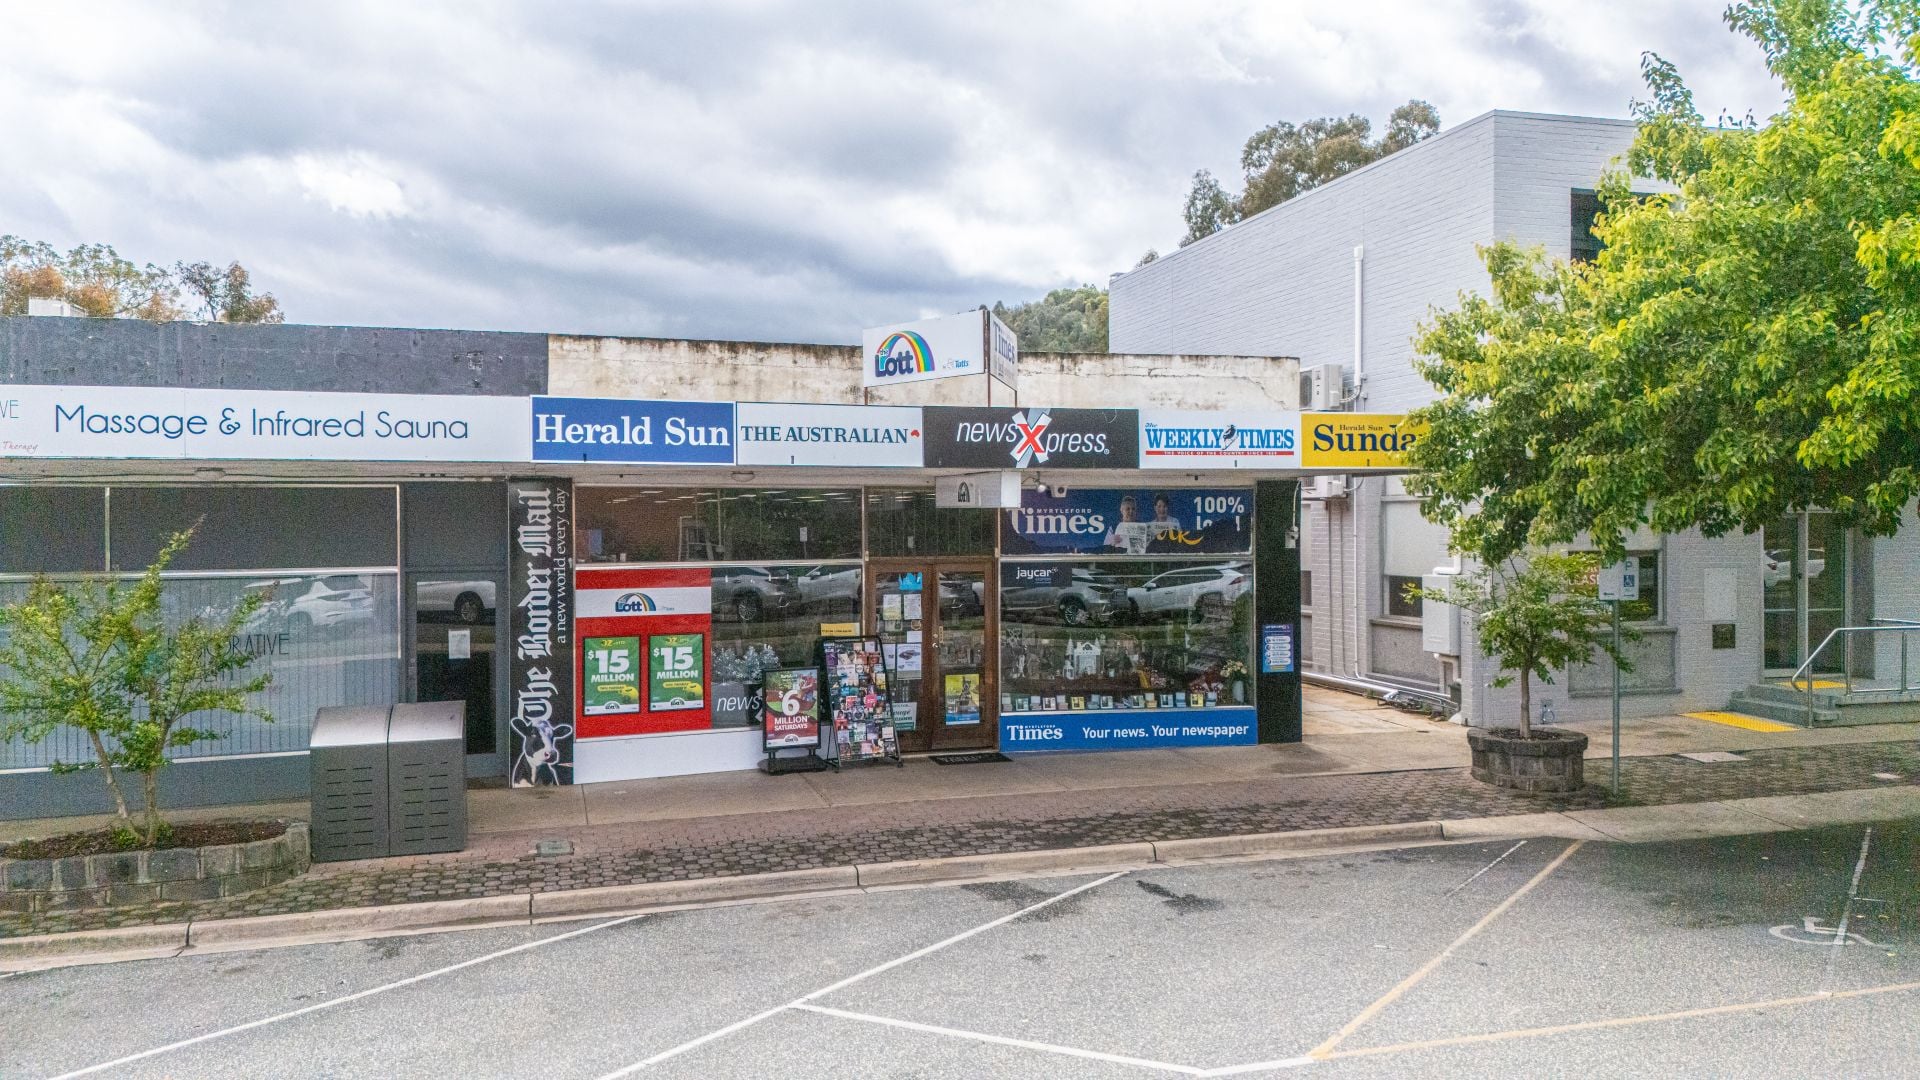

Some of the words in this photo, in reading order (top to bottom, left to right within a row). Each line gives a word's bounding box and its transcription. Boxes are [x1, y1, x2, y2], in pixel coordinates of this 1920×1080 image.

[875, 350, 914, 378] Lott
[55, 404, 208, 439] Massage
[219, 407, 241, 435] &
[252, 408, 364, 437] Infrared
[375, 411, 468, 439] Sauna
[535, 413, 653, 445] Herald
[664, 416, 730, 446] Sun
[741, 425, 782, 442] THE
[785, 426, 909, 443] AUSTRALIAN
[1145, 428, 1224, 449] WEEKLY
[1234, 428, 1295, 449] TIMES
[553, 488, 569, 513] day
[1194, 496, 1244, 513] 100%
[517, 488, 551, 557] Mail
[1006, 507, 1105, 534] Times
[556, 516, 569, 555] every
[1016, 567, 1052, 580] jaycar
[1625, 560, 1633, 571] P
[553, 557, 566, 600] world
[517, 561, 552, 660] Border
[557, 604, 566, 632] new
[615, 601, 643, 613] Lott
[557, 635, 566, 644] a
[588, 649, 630, 674] $15
[653, 646, 694, 671] $15
[591, 673, 635, 683] MILLION
[656, 669, 699, 680] MILLION
[517, 666, 558, 725] The
[778, 689, 800, 716] $6
[774, 723, 808, 731] SATURDAYS
[1006, 725, 1063, 741] Times
[1082, 727, 1110, 739] Your
[1113, 728, 1149, 738] news.
[1151, 725, 1179, 736] Your
[1182, 725, 1249, 738] newspaper
